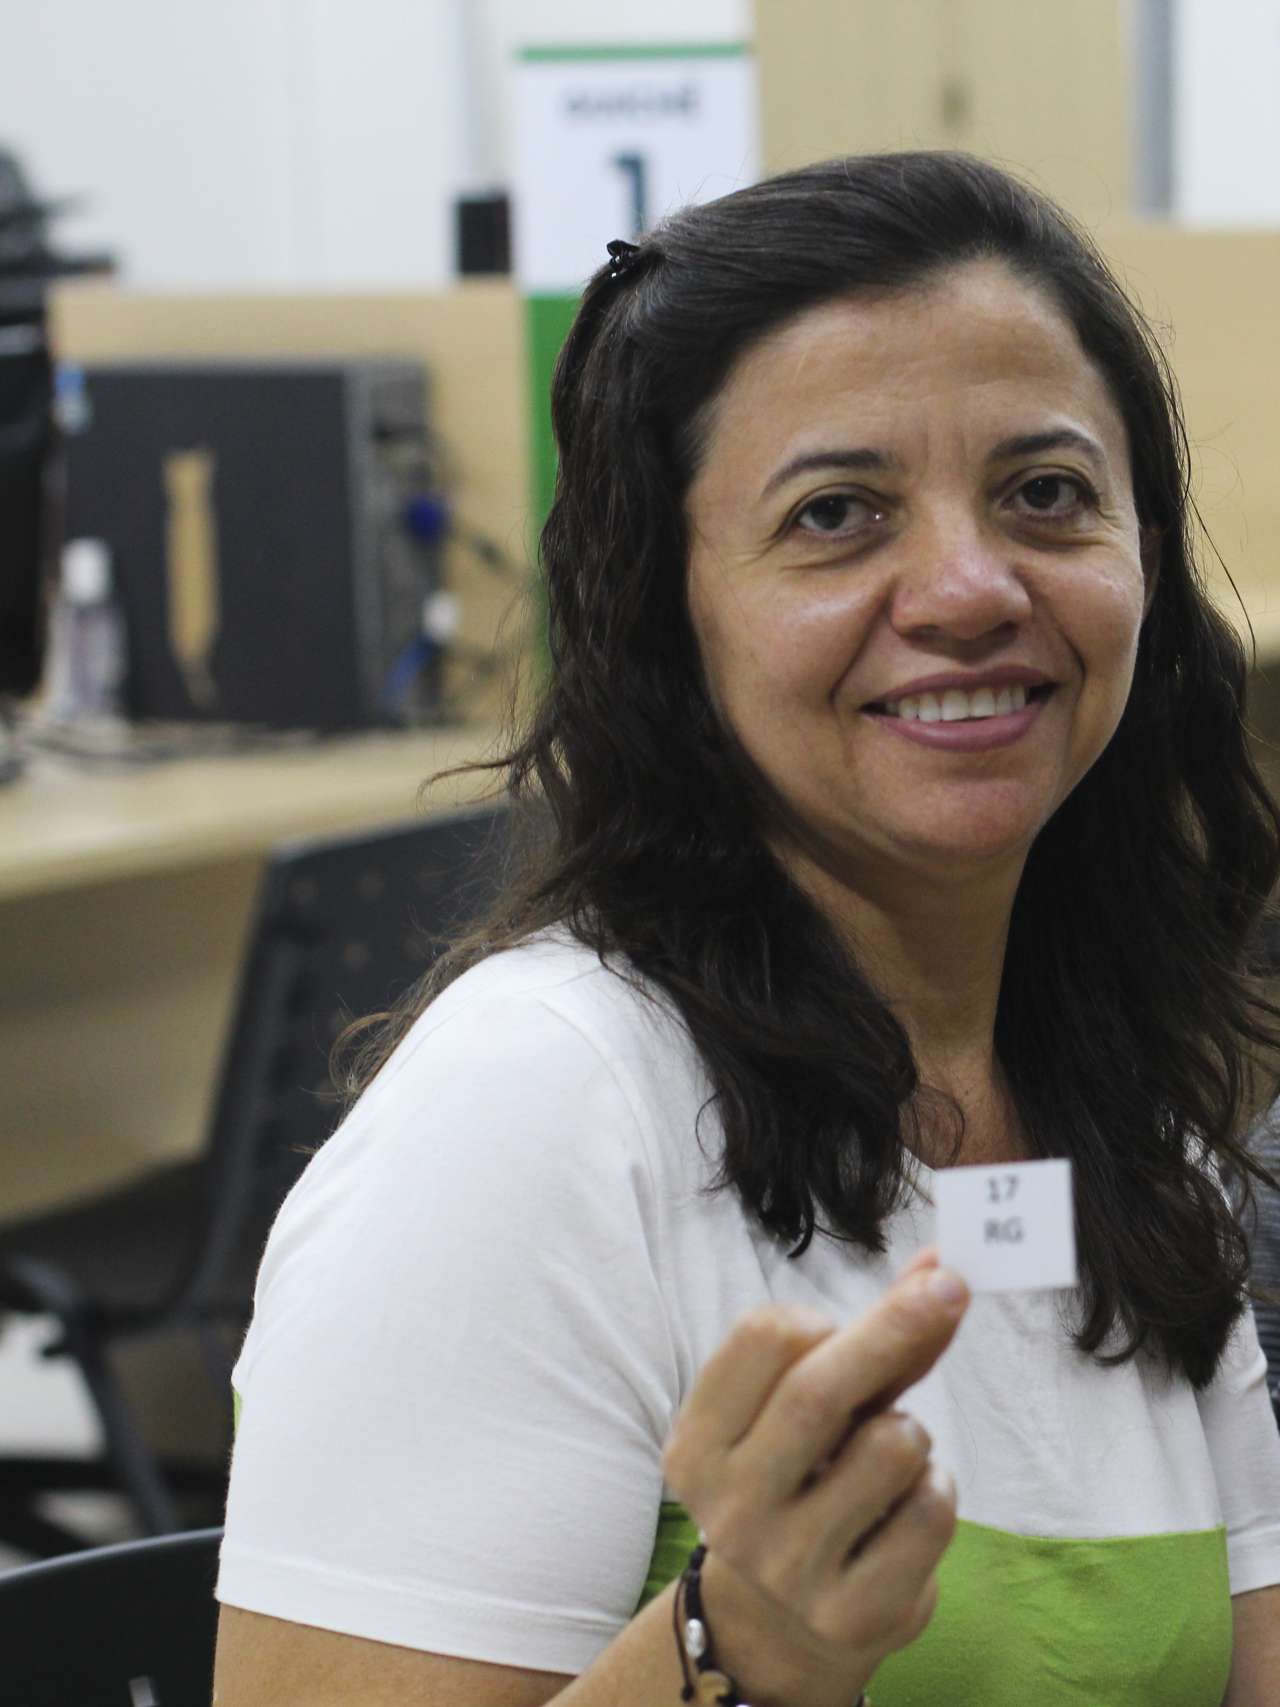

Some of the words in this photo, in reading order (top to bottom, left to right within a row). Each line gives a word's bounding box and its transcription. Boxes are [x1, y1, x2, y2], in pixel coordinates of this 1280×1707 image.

[613, 149, 649, 235] 1
[986, 1174, 1020, 1204] 17
[983, 1216, 1024, 1244] RG
